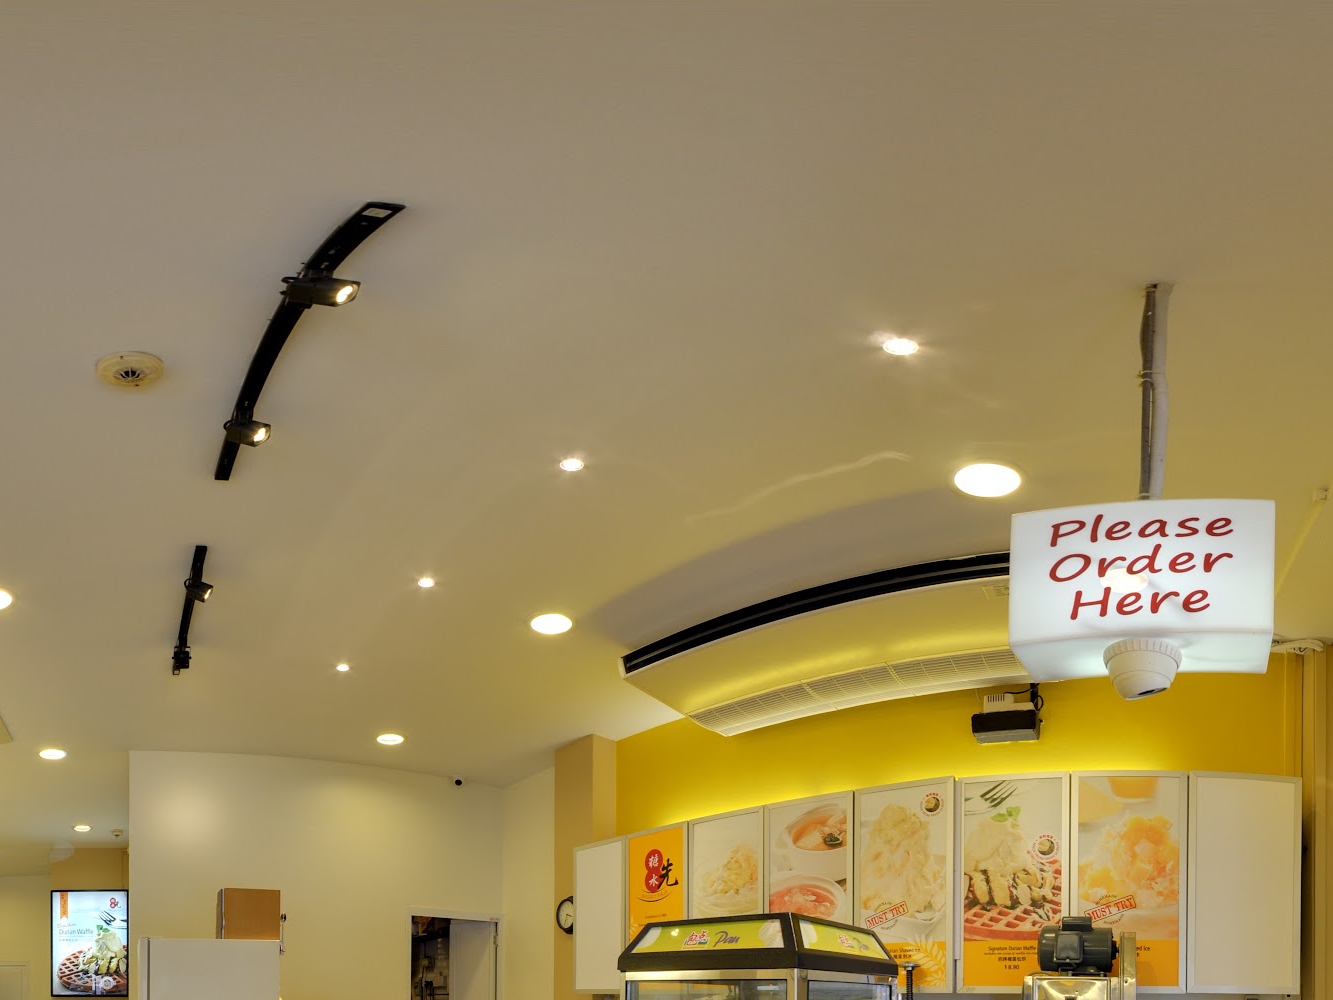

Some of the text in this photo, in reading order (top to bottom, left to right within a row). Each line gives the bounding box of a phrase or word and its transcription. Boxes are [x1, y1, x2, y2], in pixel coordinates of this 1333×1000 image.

[1050, 514, 1234, 547] Please
[1049, 543, 1234, 583] Order
[1070, 587, 1210, 620] Here
[648, 853, 679, 890] 糖水 先
[867, 903, 905, 928] MUST TRY
[1087, 897, 1134, 920] MUST TRY
